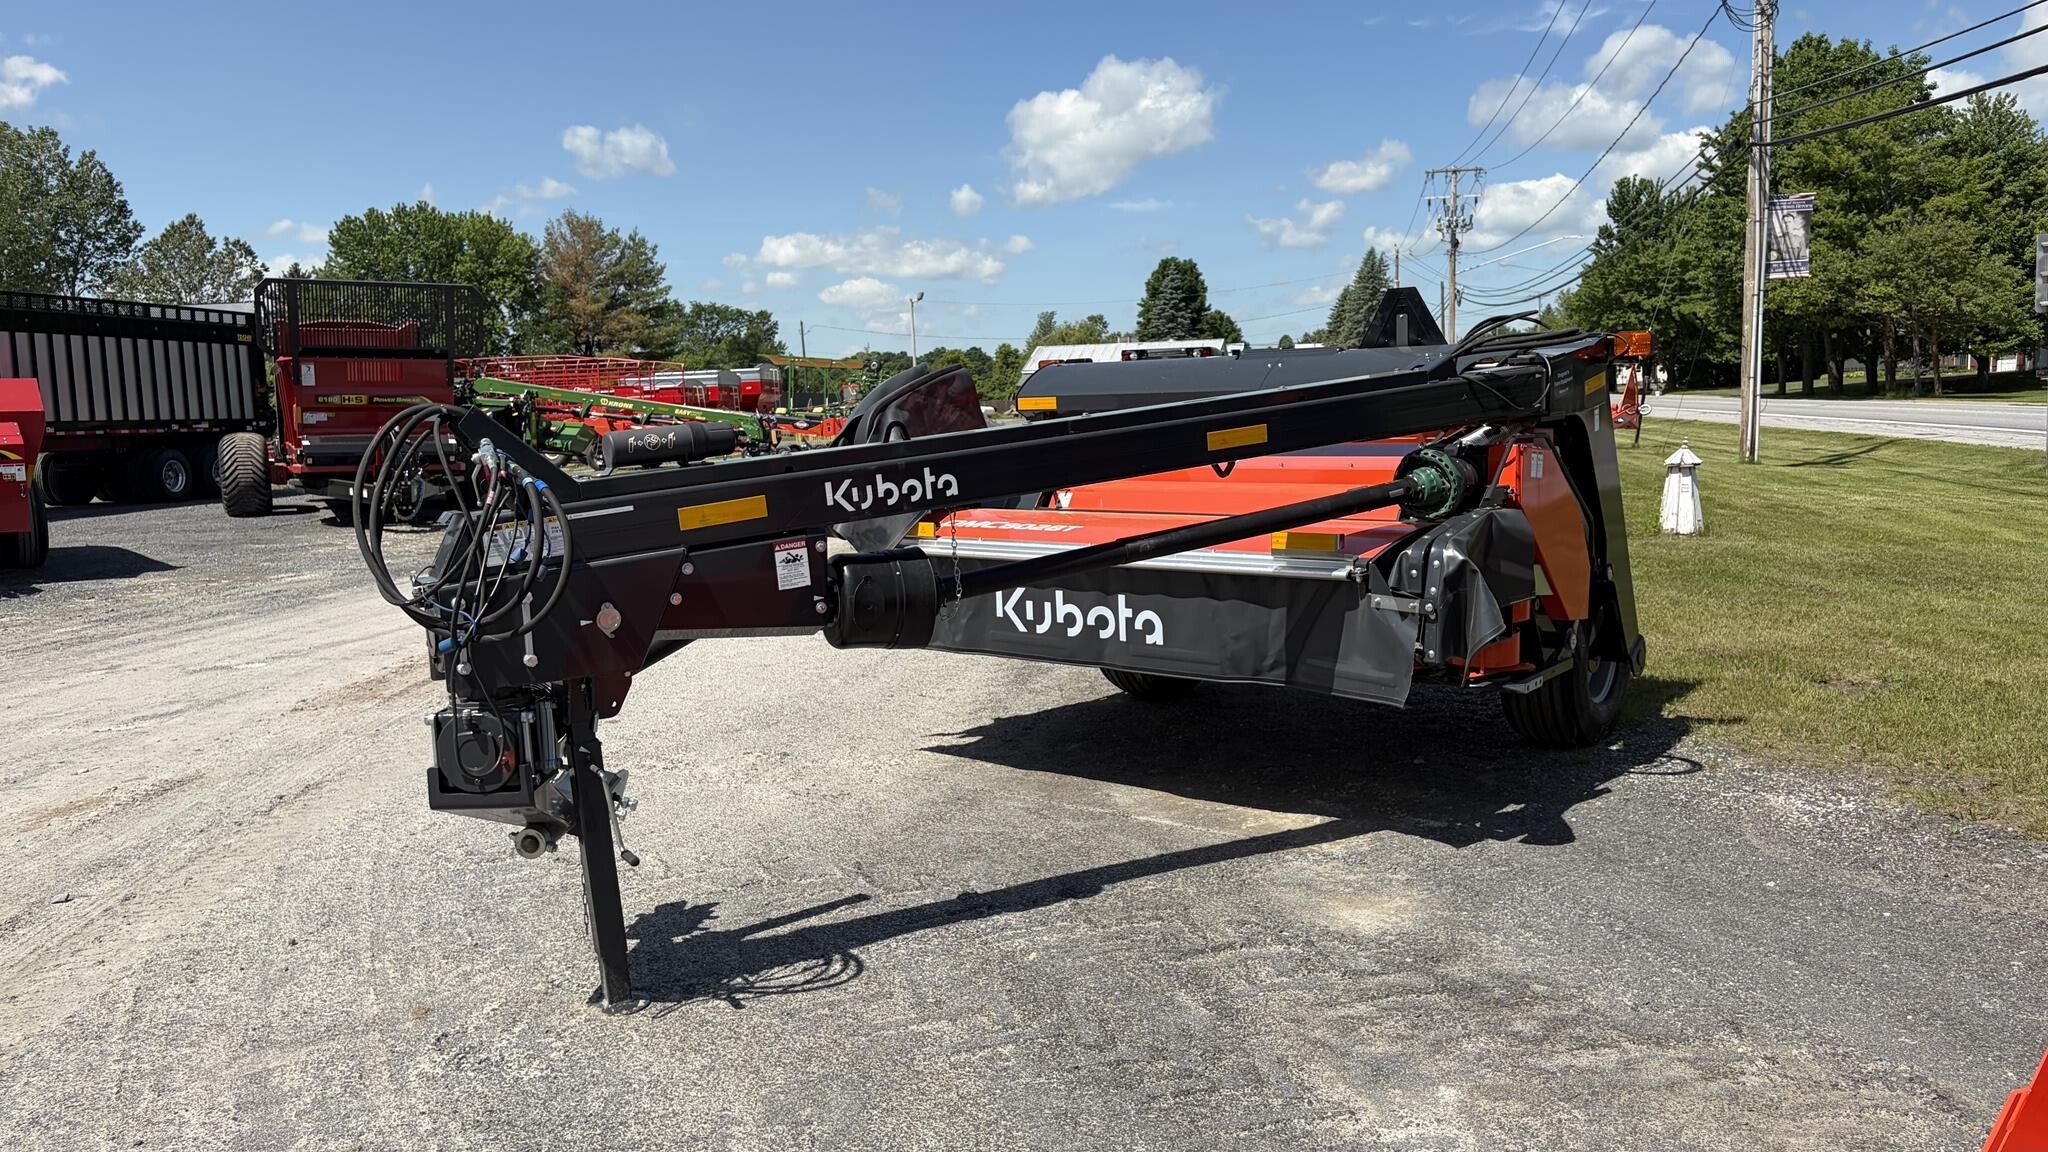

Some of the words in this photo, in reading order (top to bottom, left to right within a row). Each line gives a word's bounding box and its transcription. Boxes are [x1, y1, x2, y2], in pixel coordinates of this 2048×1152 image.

[607, 401, 634, 409] KRONE
[824, 467, 959, 512] Kubota
[780, 541, 806, 550] DANGER
[995, 587, 1164, 646] Kubota
